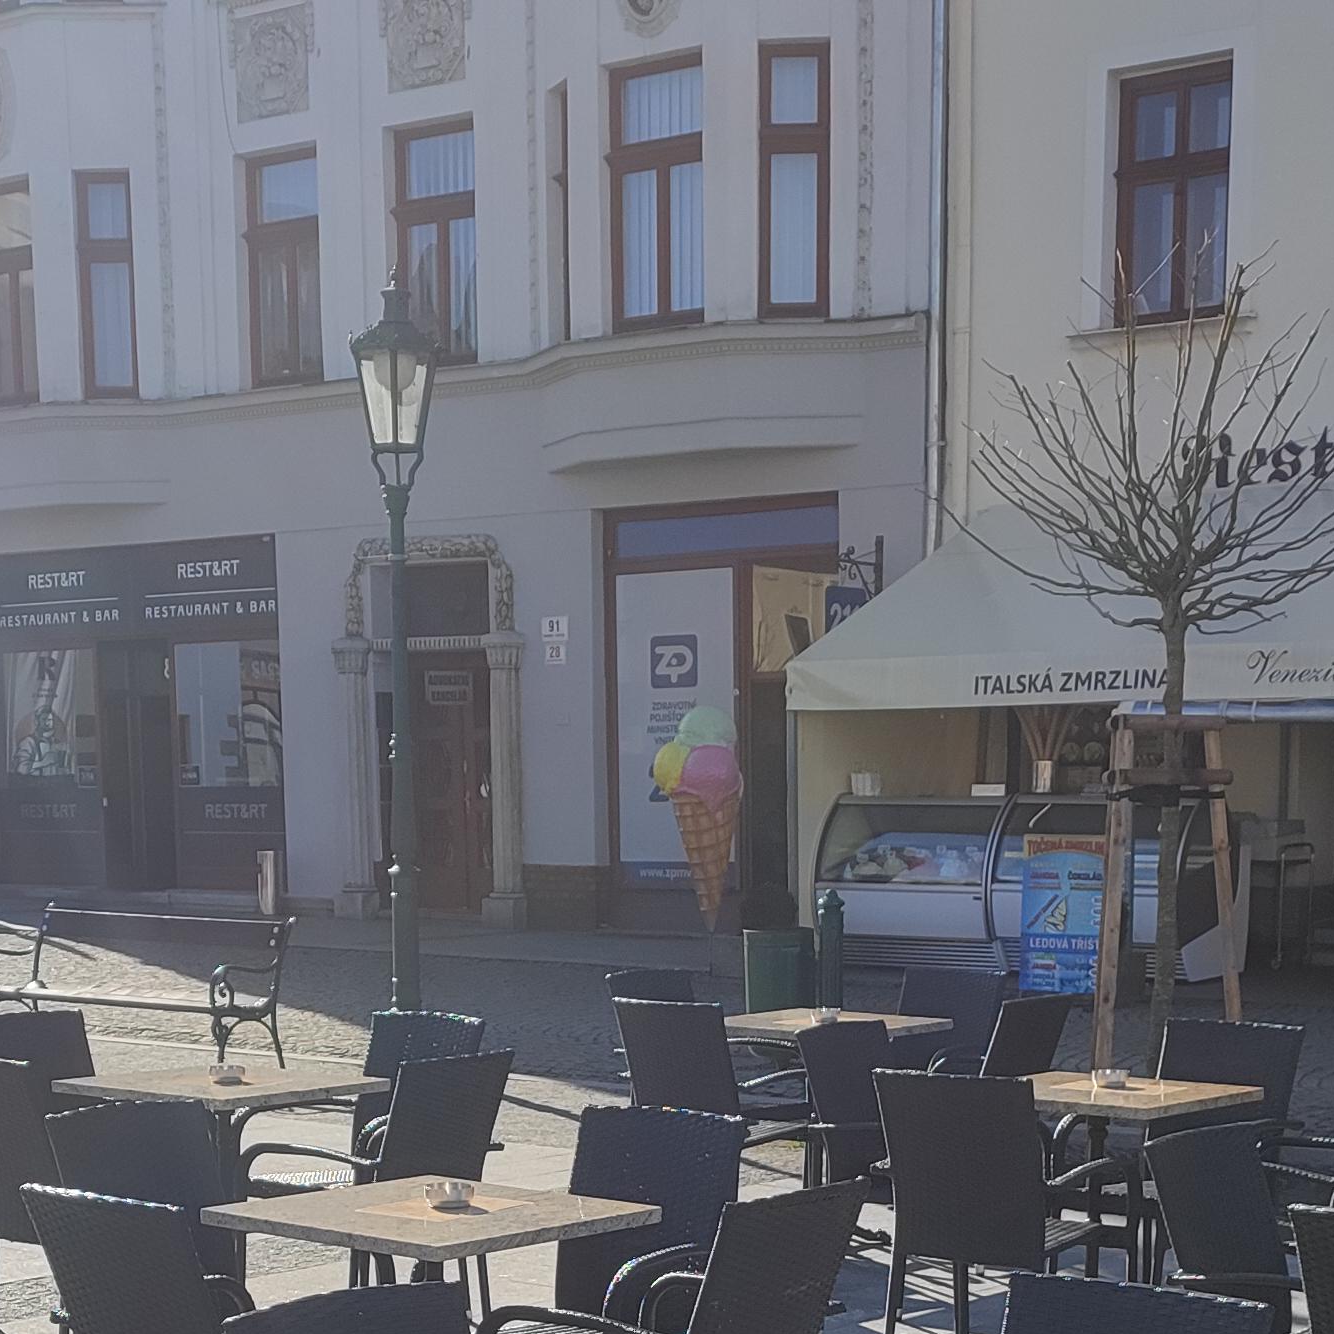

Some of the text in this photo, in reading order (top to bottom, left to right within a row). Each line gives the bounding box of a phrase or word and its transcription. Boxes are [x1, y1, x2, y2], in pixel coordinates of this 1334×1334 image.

[177, 560, 240, 579] REST&RT
[28, 571, 85, 590] REST&RT
[145, 599, 276, 619] RESTAURANT & BAR
[0, 609, 119, 628] RESTAURANT & BAR
[548, 620, 560, 632] 91
[549, 646, 561, 658] 28
[974, 667, 1168, 695] ITALSKÁ ZMRZLINA
[21, 803, 76, 819] REST&RT
[205, 803, 268, 819] REST&RT
[1029, 937, 1069, 949] LEDOVÁ
